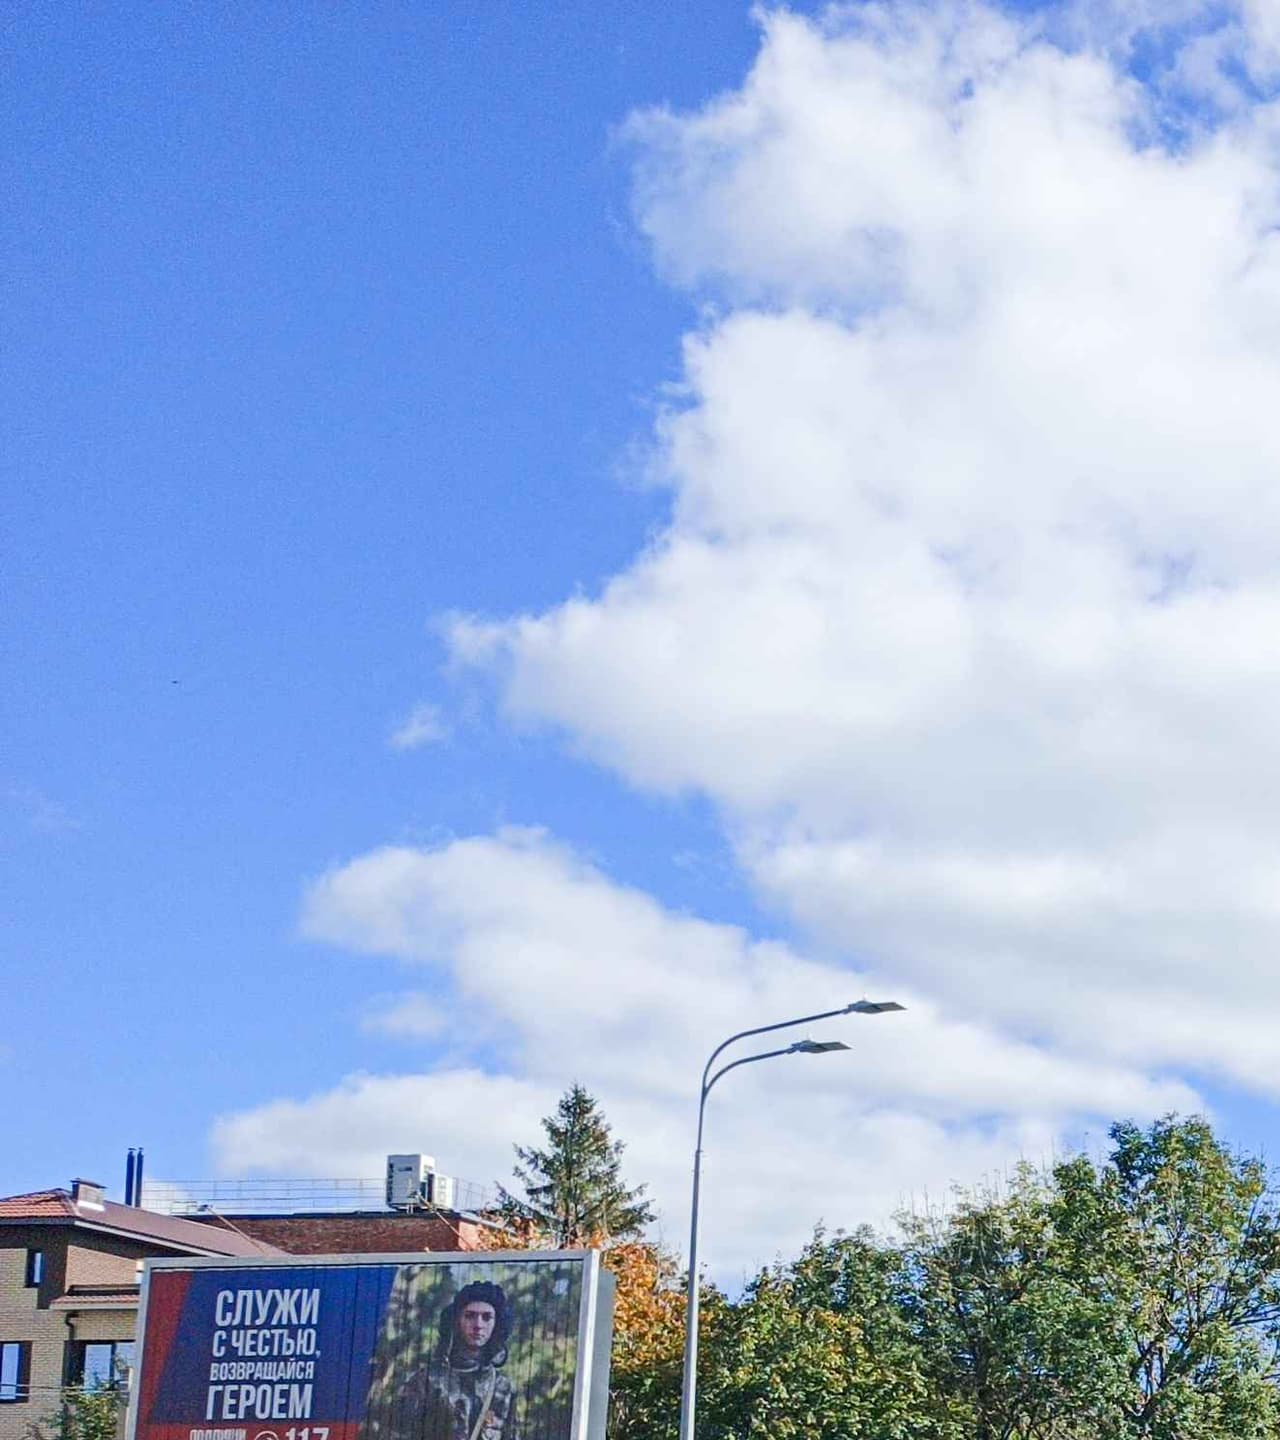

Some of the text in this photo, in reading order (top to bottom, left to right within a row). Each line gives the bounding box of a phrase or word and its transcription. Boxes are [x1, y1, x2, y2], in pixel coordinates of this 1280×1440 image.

[215, 1288, 320, 1327] СЛУЖИ
[212, 1328, 321, 1358] С ЧЕСТЬЮ,
[209, 1358, 315, 1382] ВОЗВРАЩАЙСЯ
[206, 1384, 313, 1420] ГЕРОЕМ
